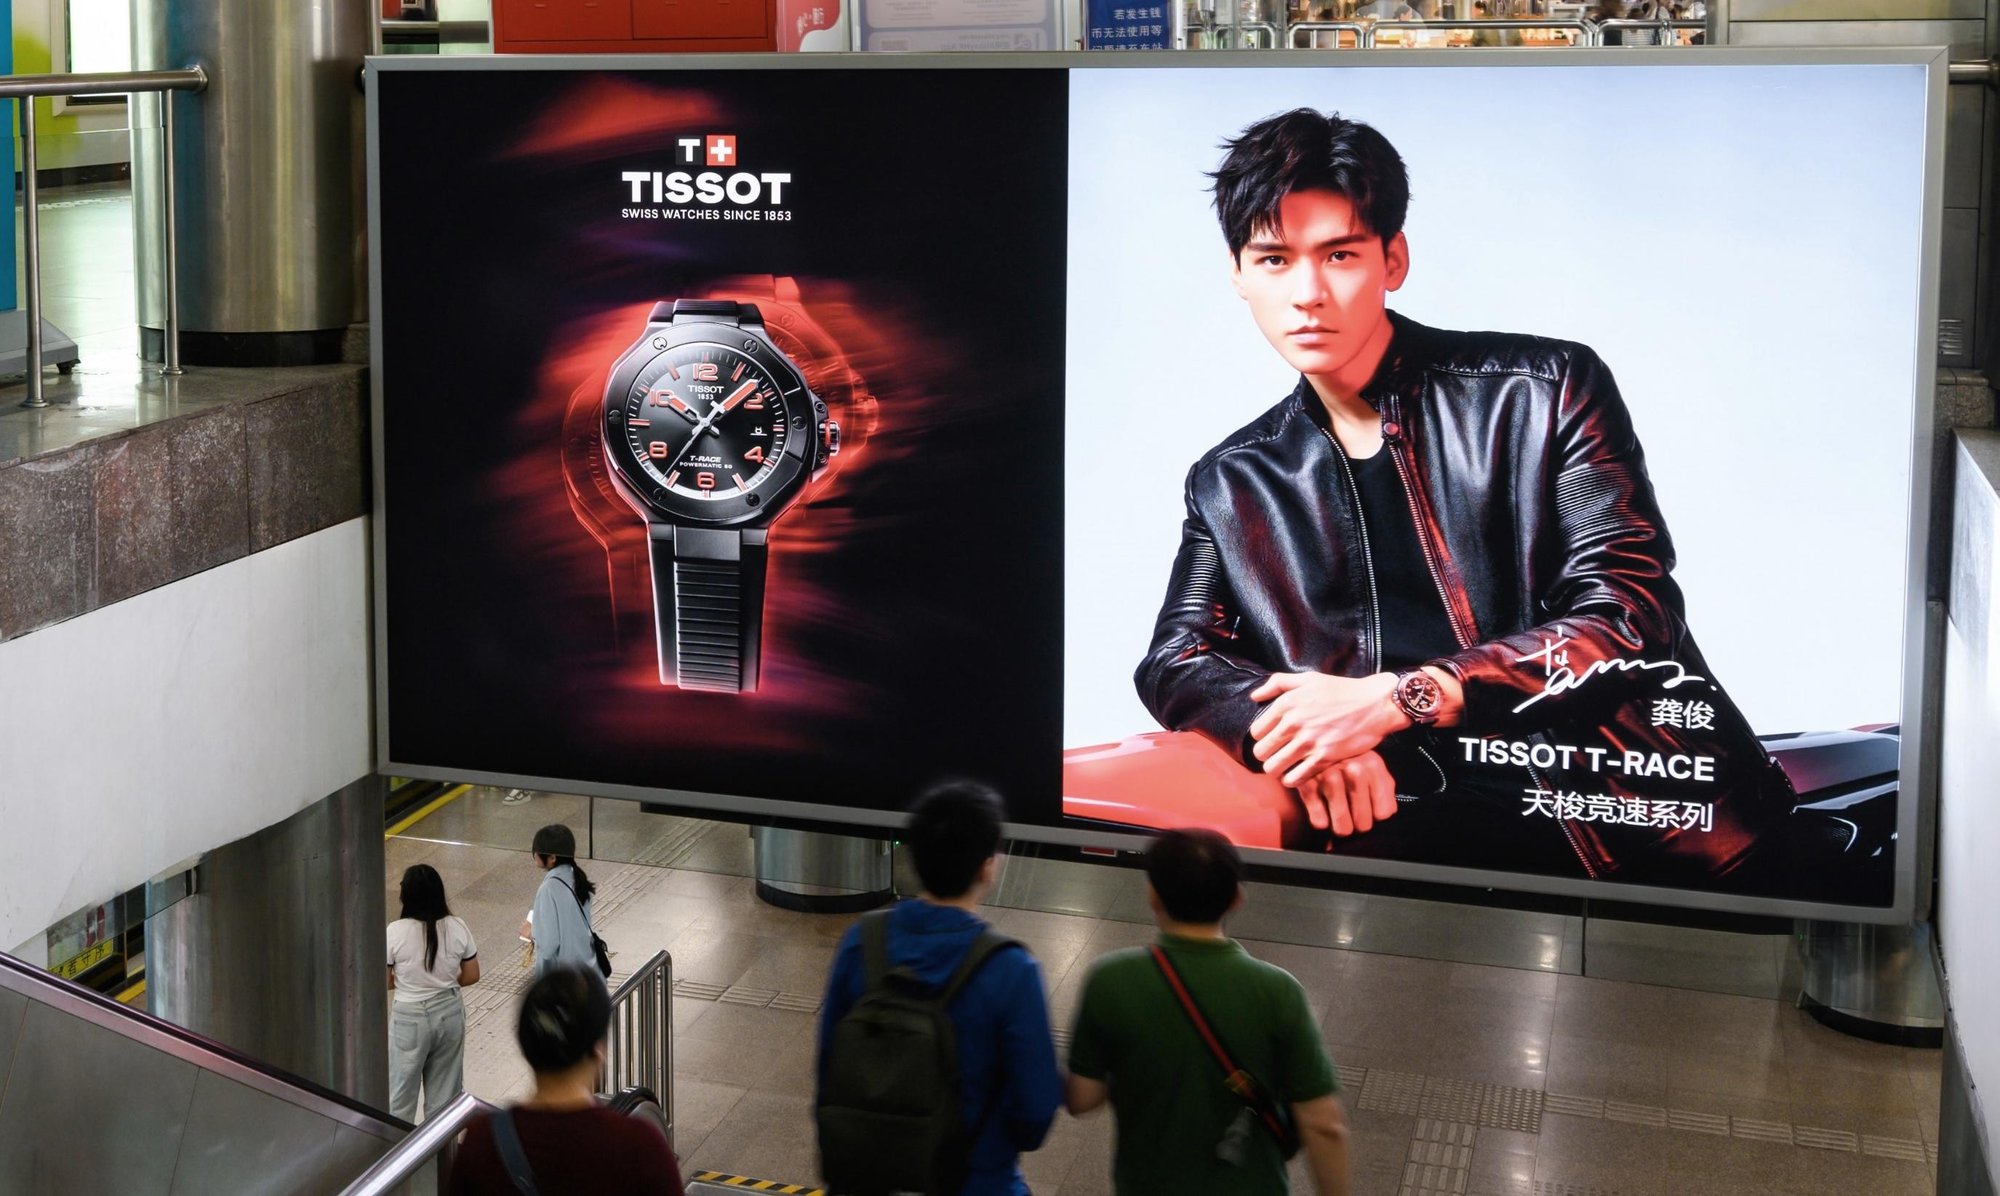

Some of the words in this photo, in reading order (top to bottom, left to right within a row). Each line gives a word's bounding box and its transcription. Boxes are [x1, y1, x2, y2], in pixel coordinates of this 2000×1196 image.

[622, 171, 791, 205] TISSOT
[622, 208, 658, 219] SWISS
[662, 209, 719, 220] WATCHES
[723, 210, 760, 220] SINCE
[764, 211, 791, 221] 1853
[693, 363, 718, 381] 12
[688, 385, 724, 393] TISSOT
[649, 441, 668, 458] 8
[744, 446, 763, 463] 4
[690, 455, 722, 463] T-RACE
[697, 472, 715, 488] 6
[1651, 698, 1715, 730] 龚俊
[1458, 737, 1577, 770] TISSOT
[1585, 749, 1715, 782] T-RACE
[1522, 788, 1714, 832] 天梭竞速系列
